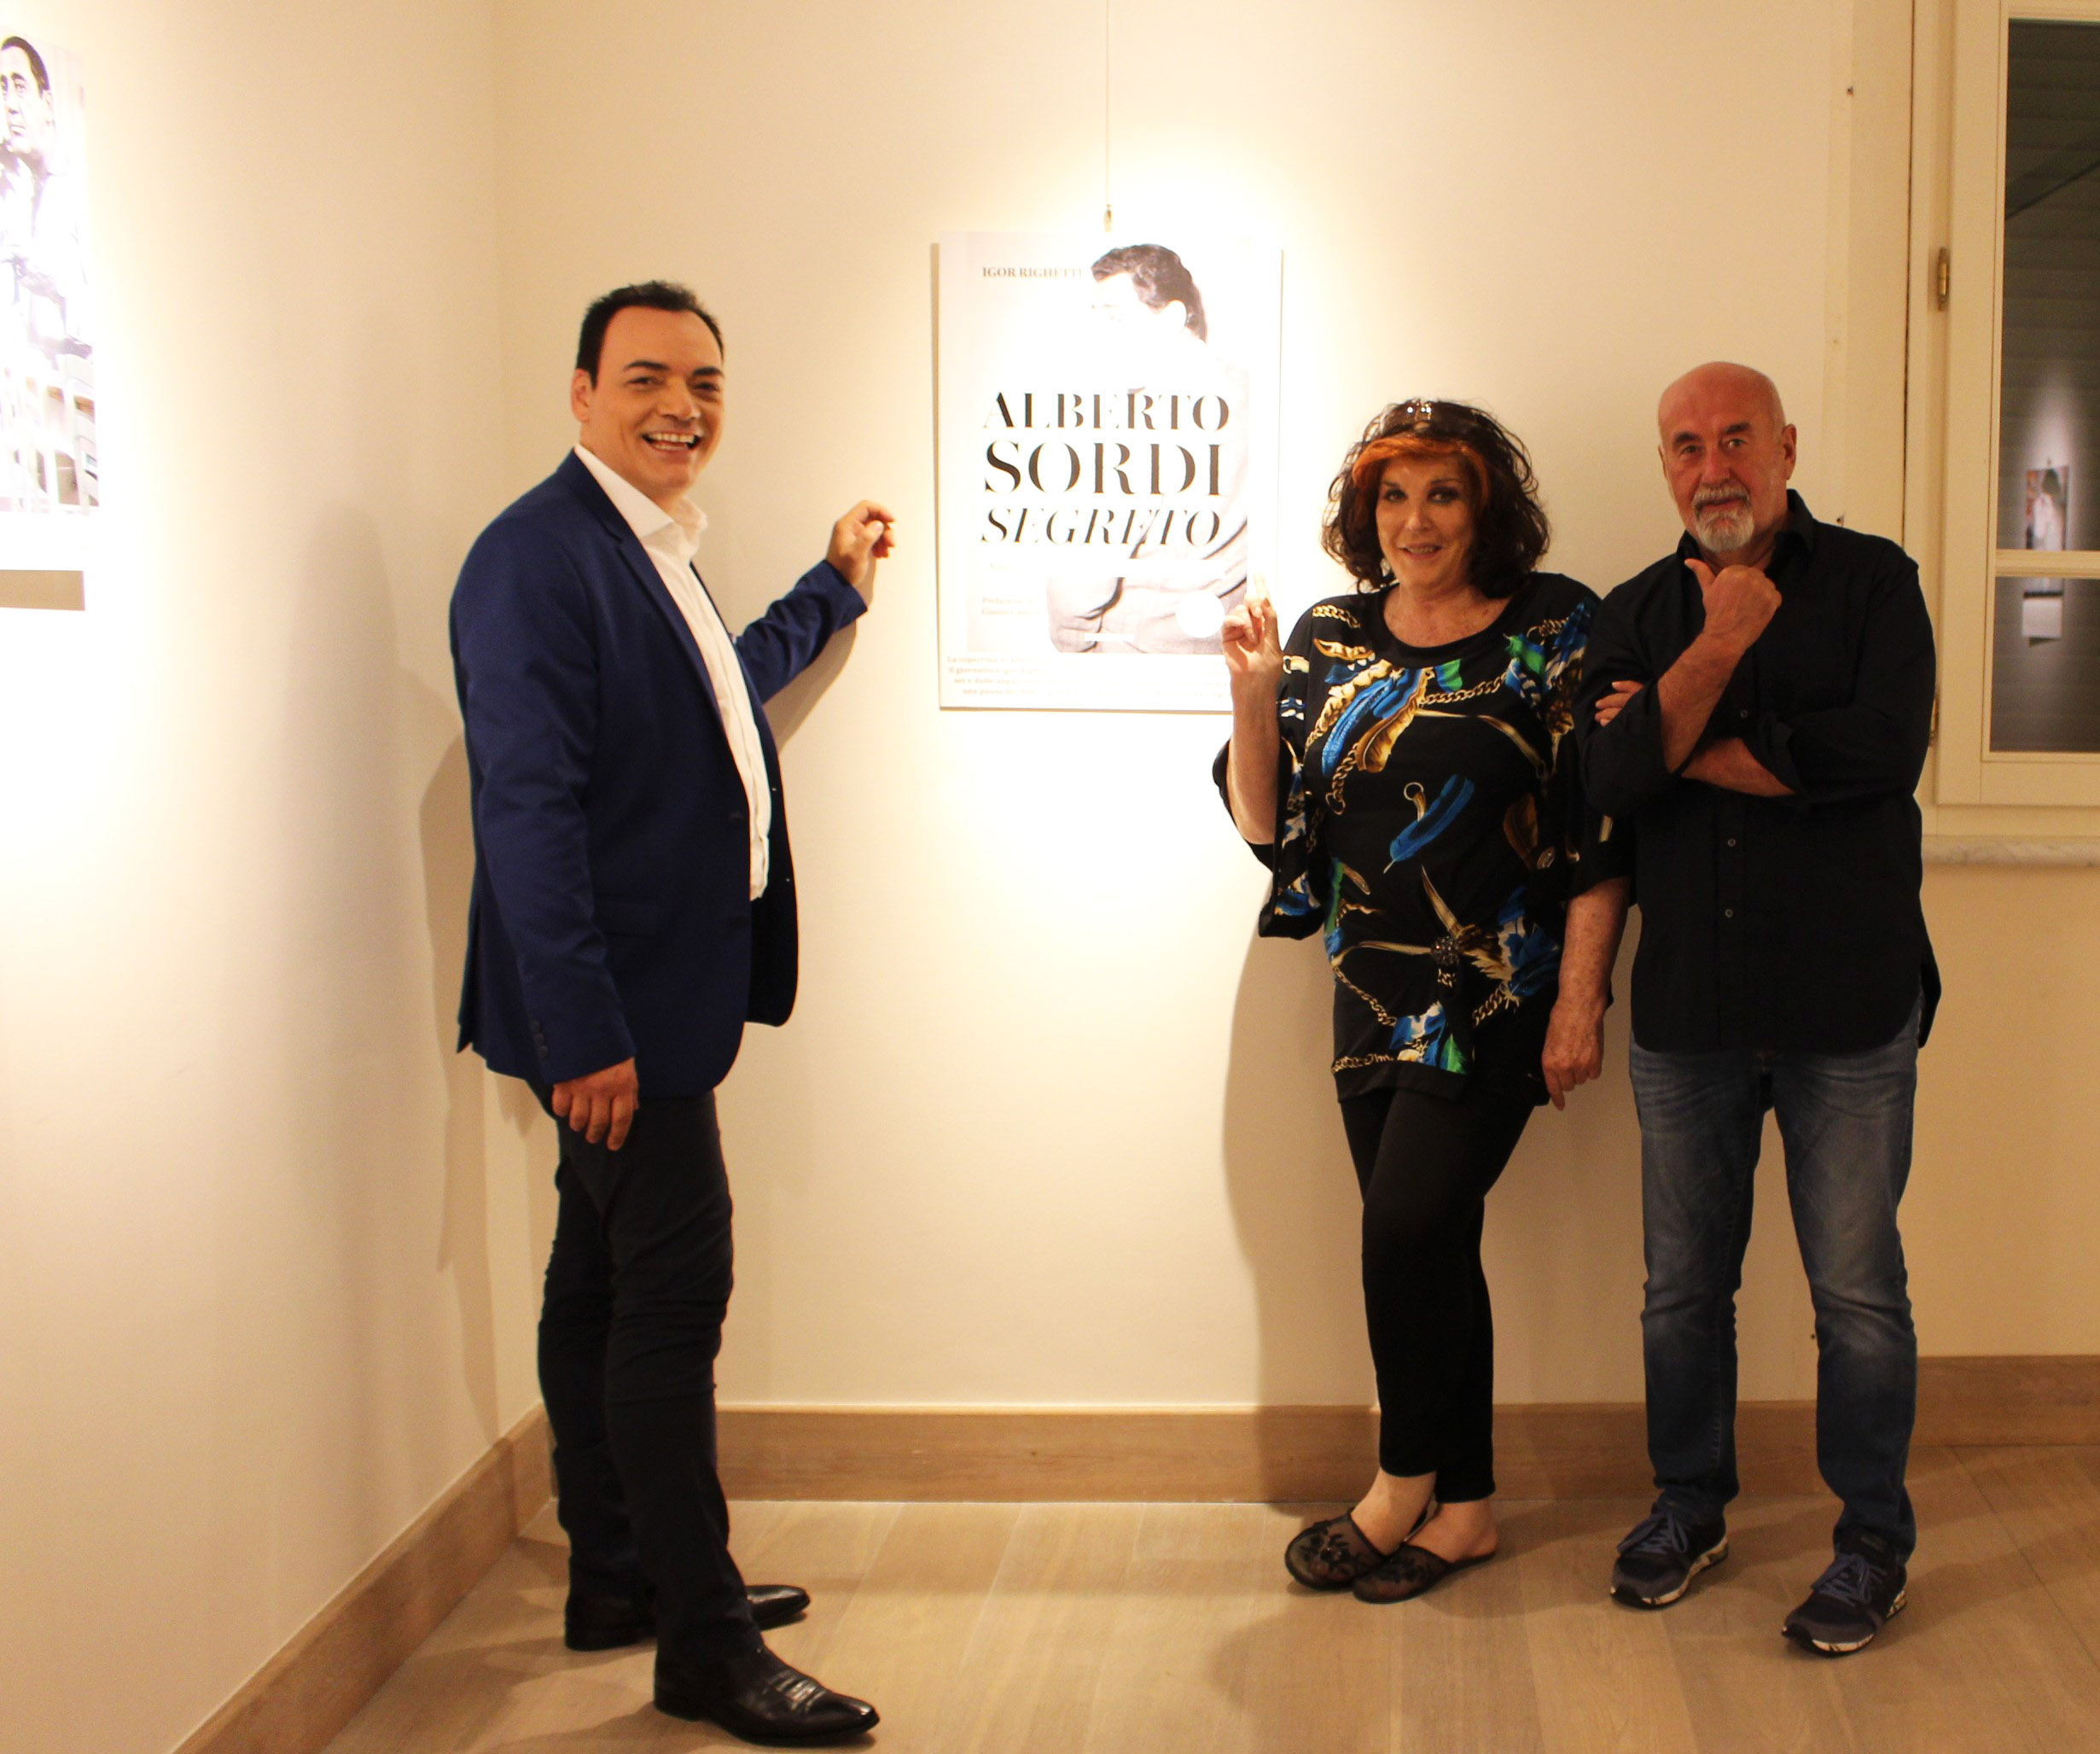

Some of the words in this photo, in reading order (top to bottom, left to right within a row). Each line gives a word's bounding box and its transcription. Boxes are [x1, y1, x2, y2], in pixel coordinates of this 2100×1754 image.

[982, 266, 1015, 277] IGOR
[1019, 267, 1083, 278] RIGHETTI
[982, 391, 1230, 432] ALBERTO
[984, 439, 1224, 497] SORDI
[980, 507, 1221, 546] SEGRETO
